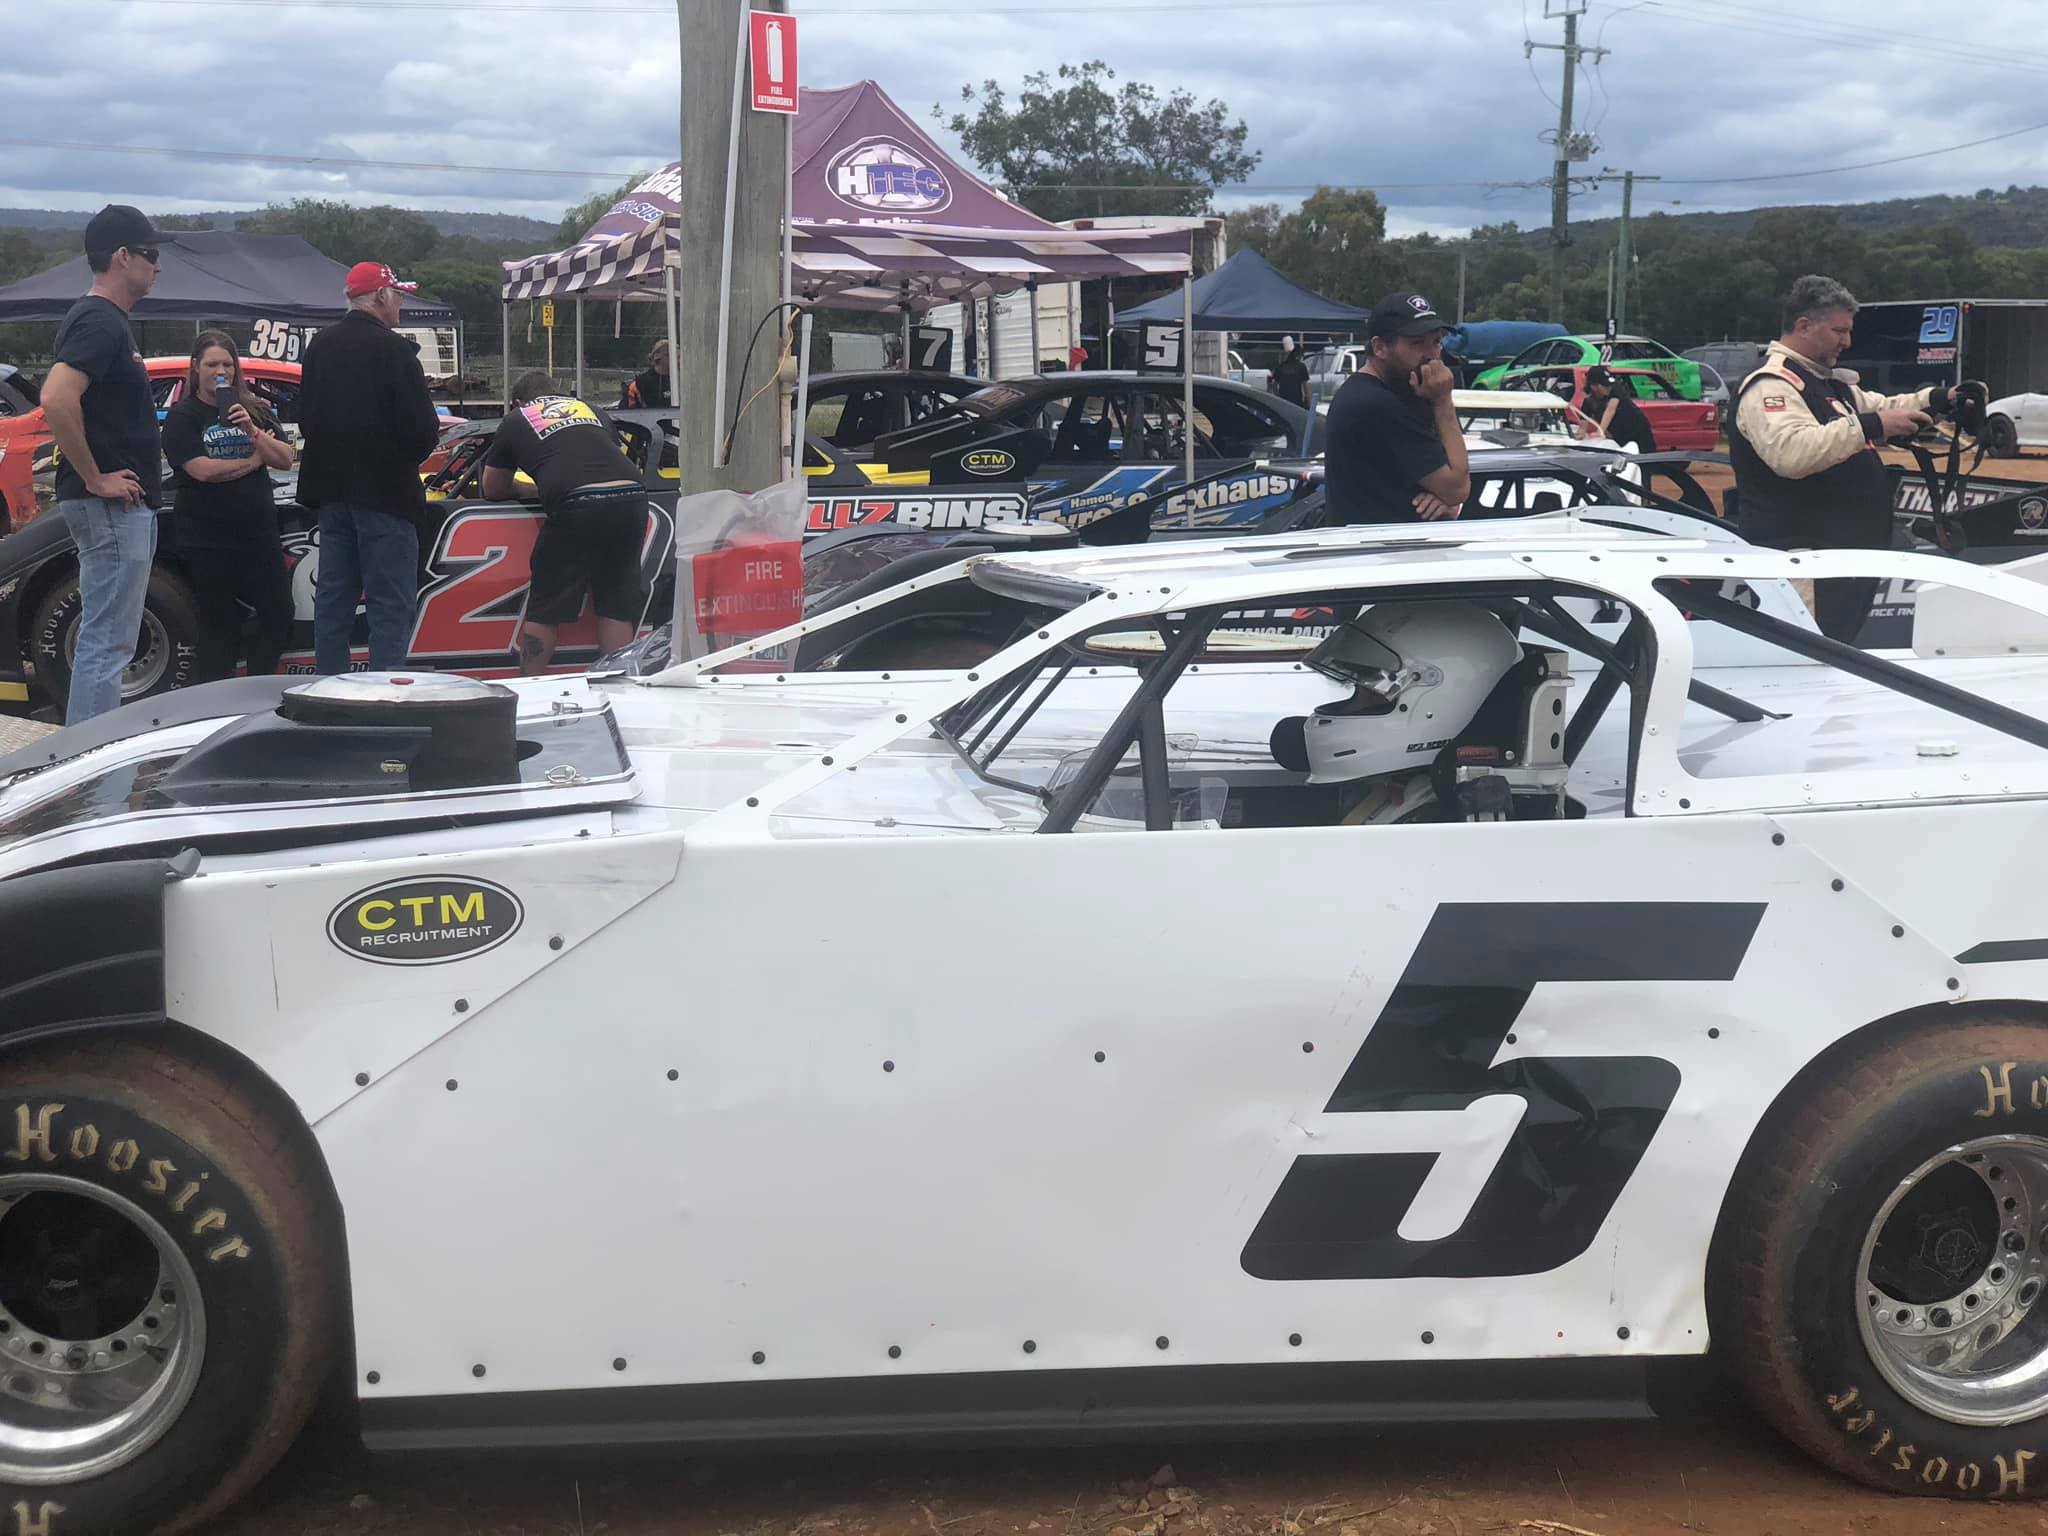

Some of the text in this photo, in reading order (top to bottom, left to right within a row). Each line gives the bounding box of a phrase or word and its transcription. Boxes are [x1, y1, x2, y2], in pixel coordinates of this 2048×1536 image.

[918, 329, 947, 367] 7
[1145, 325, 1180, 368] 5
[203, 427, 248, 443] AUSTRA
[968, 453, 1006, 466] CTM
[897, 500, 1026, 528] BINS
[1070, 493, 1113, 509] Hamon
[744, 560, 783, 582] FIRE
[357, 891, 486, 931] CTM
[360, 925, 493, 947] RECRUITMENT
[1240, 902, 1769, 1280] 5
[5, 1102, 251, 1262] Hoosier
[1826, 1386, 2037, 1498] Hoosier
